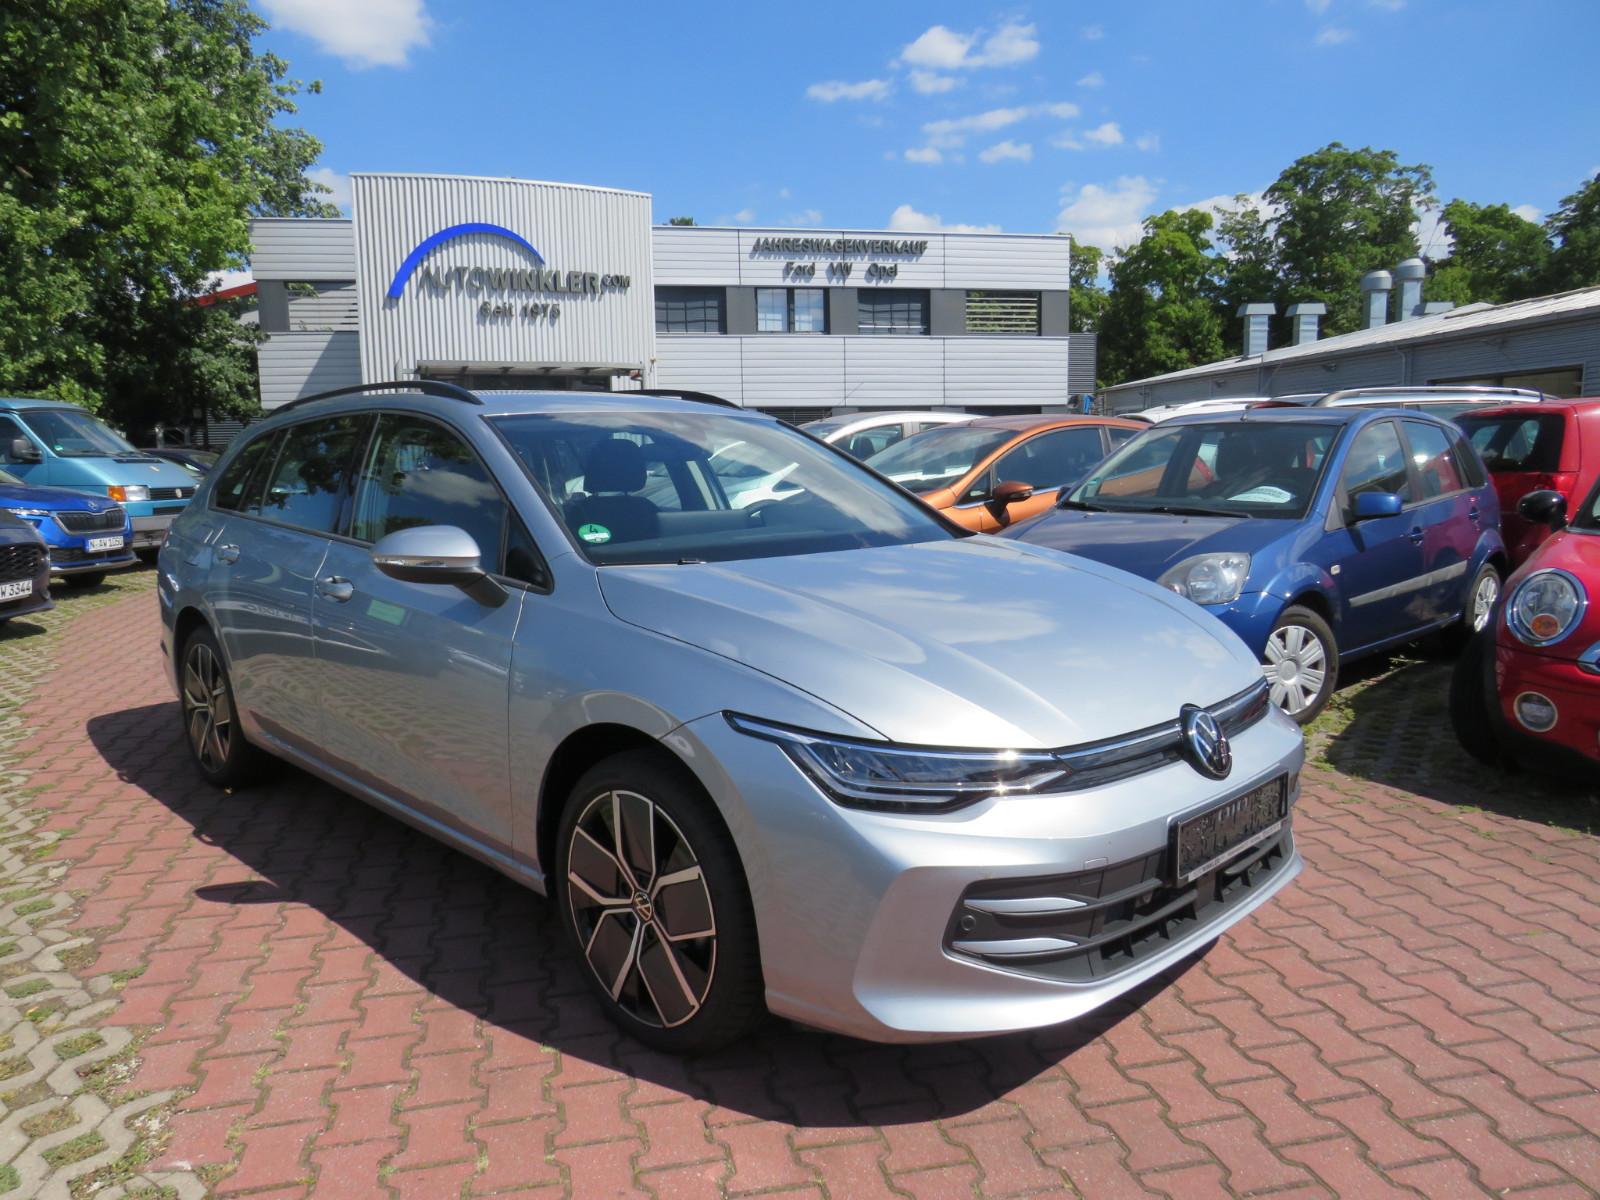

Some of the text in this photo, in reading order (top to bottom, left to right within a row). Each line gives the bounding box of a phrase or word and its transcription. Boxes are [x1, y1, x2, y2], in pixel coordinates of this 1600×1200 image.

[752, 237, 928, 255] JAHRESWAGENVERKAUF
[786, 262, 897, 280] Ford VW Opel
[479, 301, 514, 318] Seit
[9, 581, 31, 596] 3344
